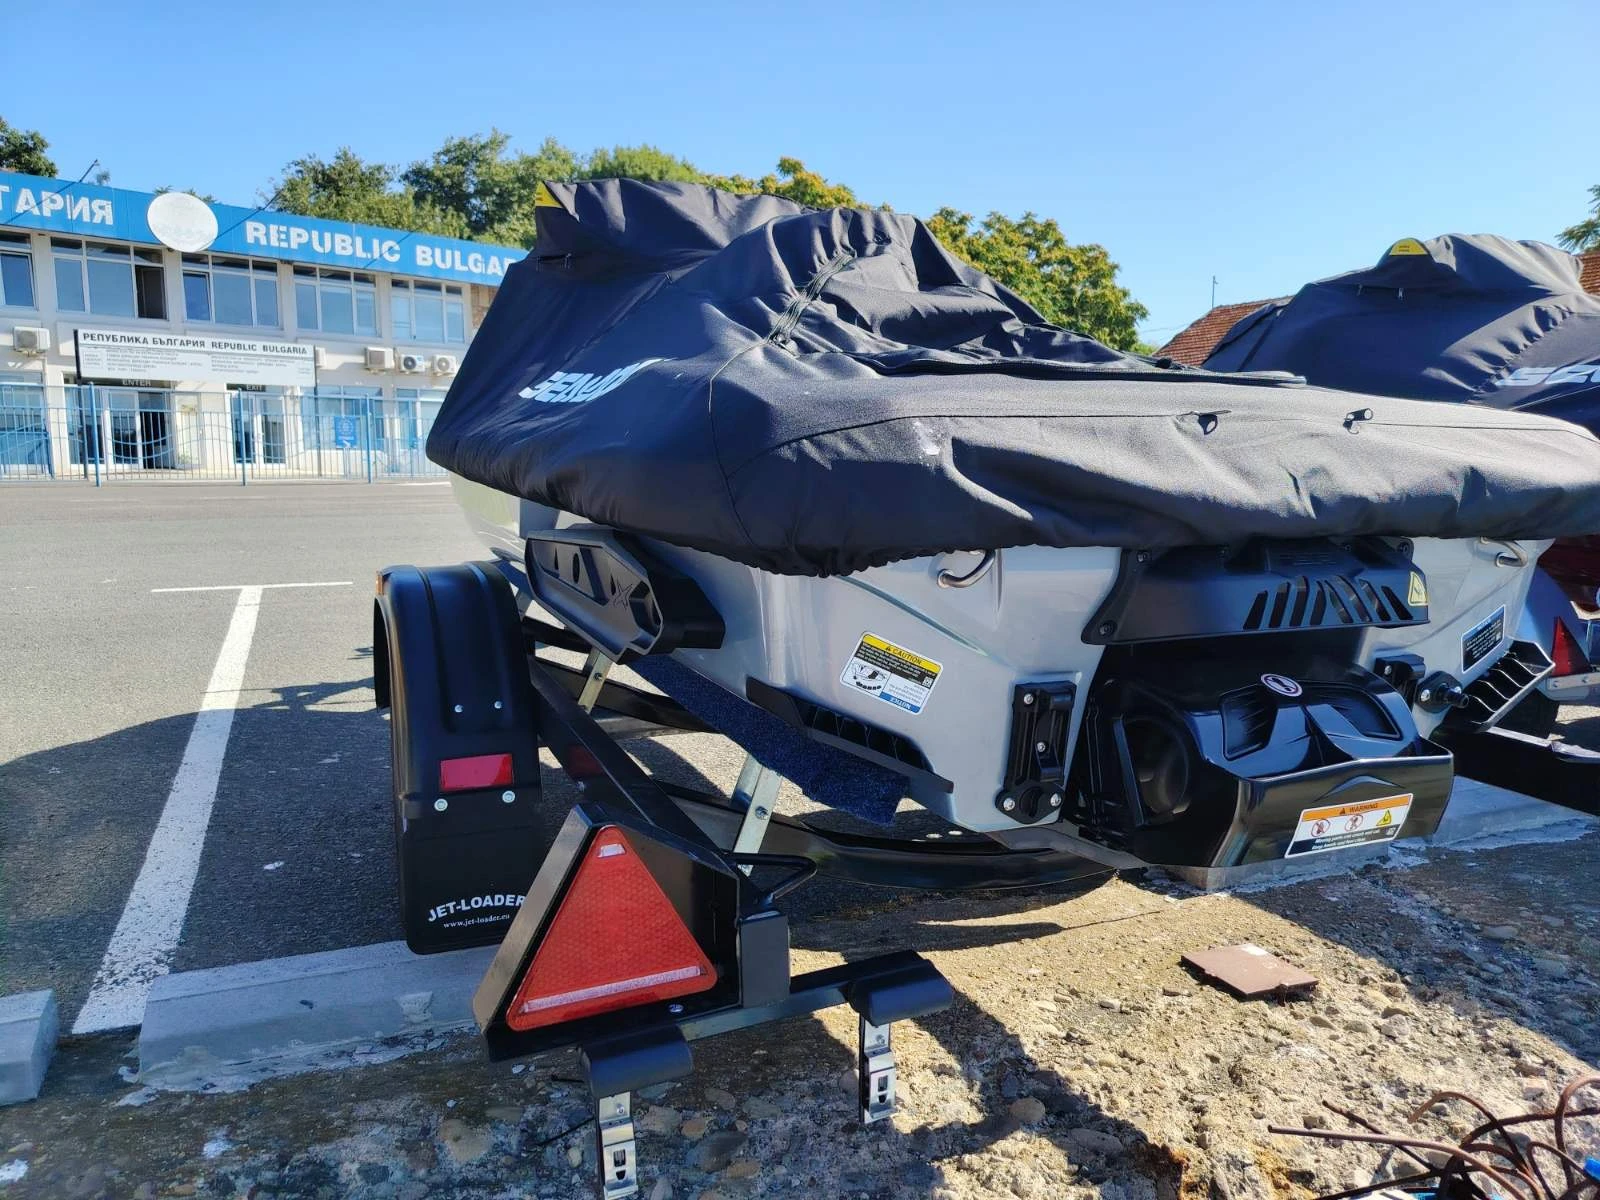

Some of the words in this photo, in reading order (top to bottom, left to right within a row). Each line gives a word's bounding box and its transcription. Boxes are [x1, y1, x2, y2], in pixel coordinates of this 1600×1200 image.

[245, 221, 401, 263] REPUBLIC
[83, 333, 149, 345] РЕПУБЛИКА
[152, 337, 205, 348] БЪЛГАРИЯ
[211, 341, 257, 352] REPUBLIC
[262, 344, 308, 355] BULGARIA
[892, 647, 922, 665] CAUTION
[1349, 803, 1378, 813] WARNING
[428, 894, 527, 922] JET-LOADER
[443, 913, 510, 929] www.jet-loader.eu
